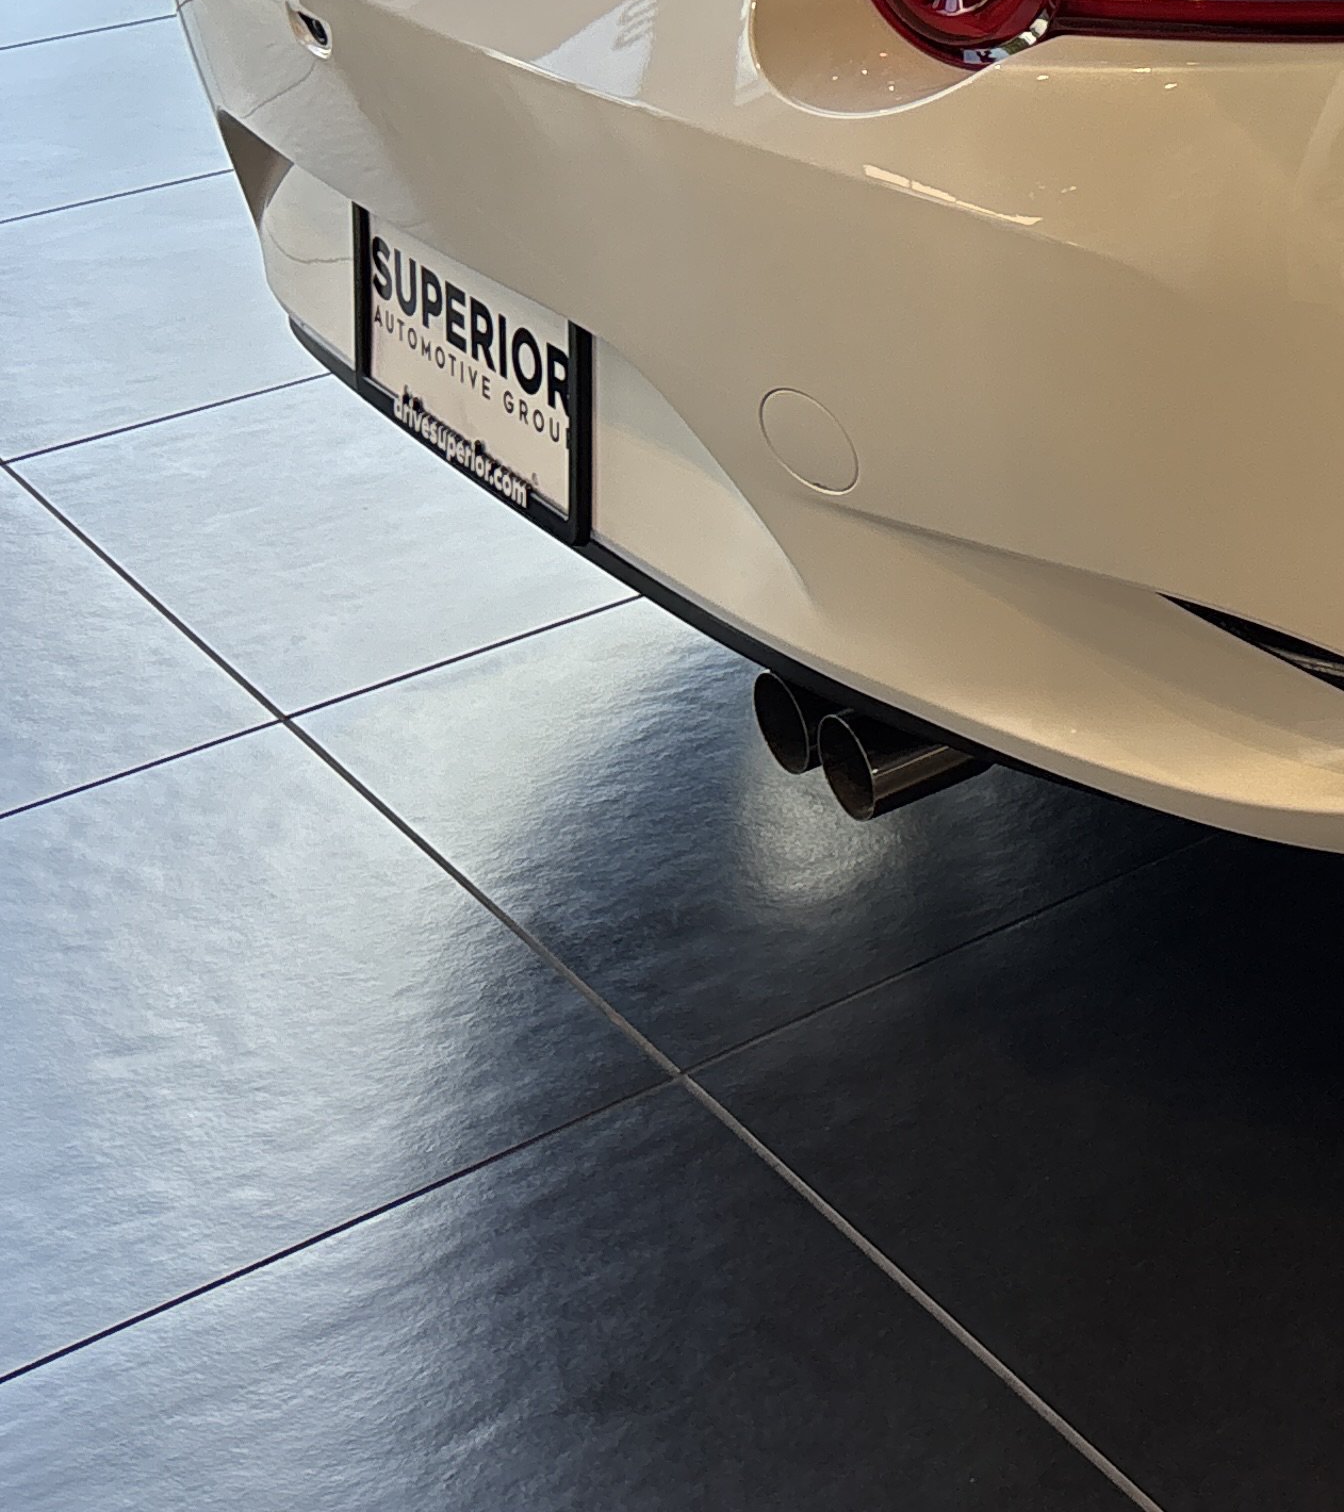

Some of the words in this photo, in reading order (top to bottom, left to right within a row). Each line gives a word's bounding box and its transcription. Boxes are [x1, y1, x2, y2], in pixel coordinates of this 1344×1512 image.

[372, 235, 569, 416] SUPERIOR
[373, 305, 491, 401] AUTOMOTIVE
[393, 386, 528, 509] drivesuperior.com
